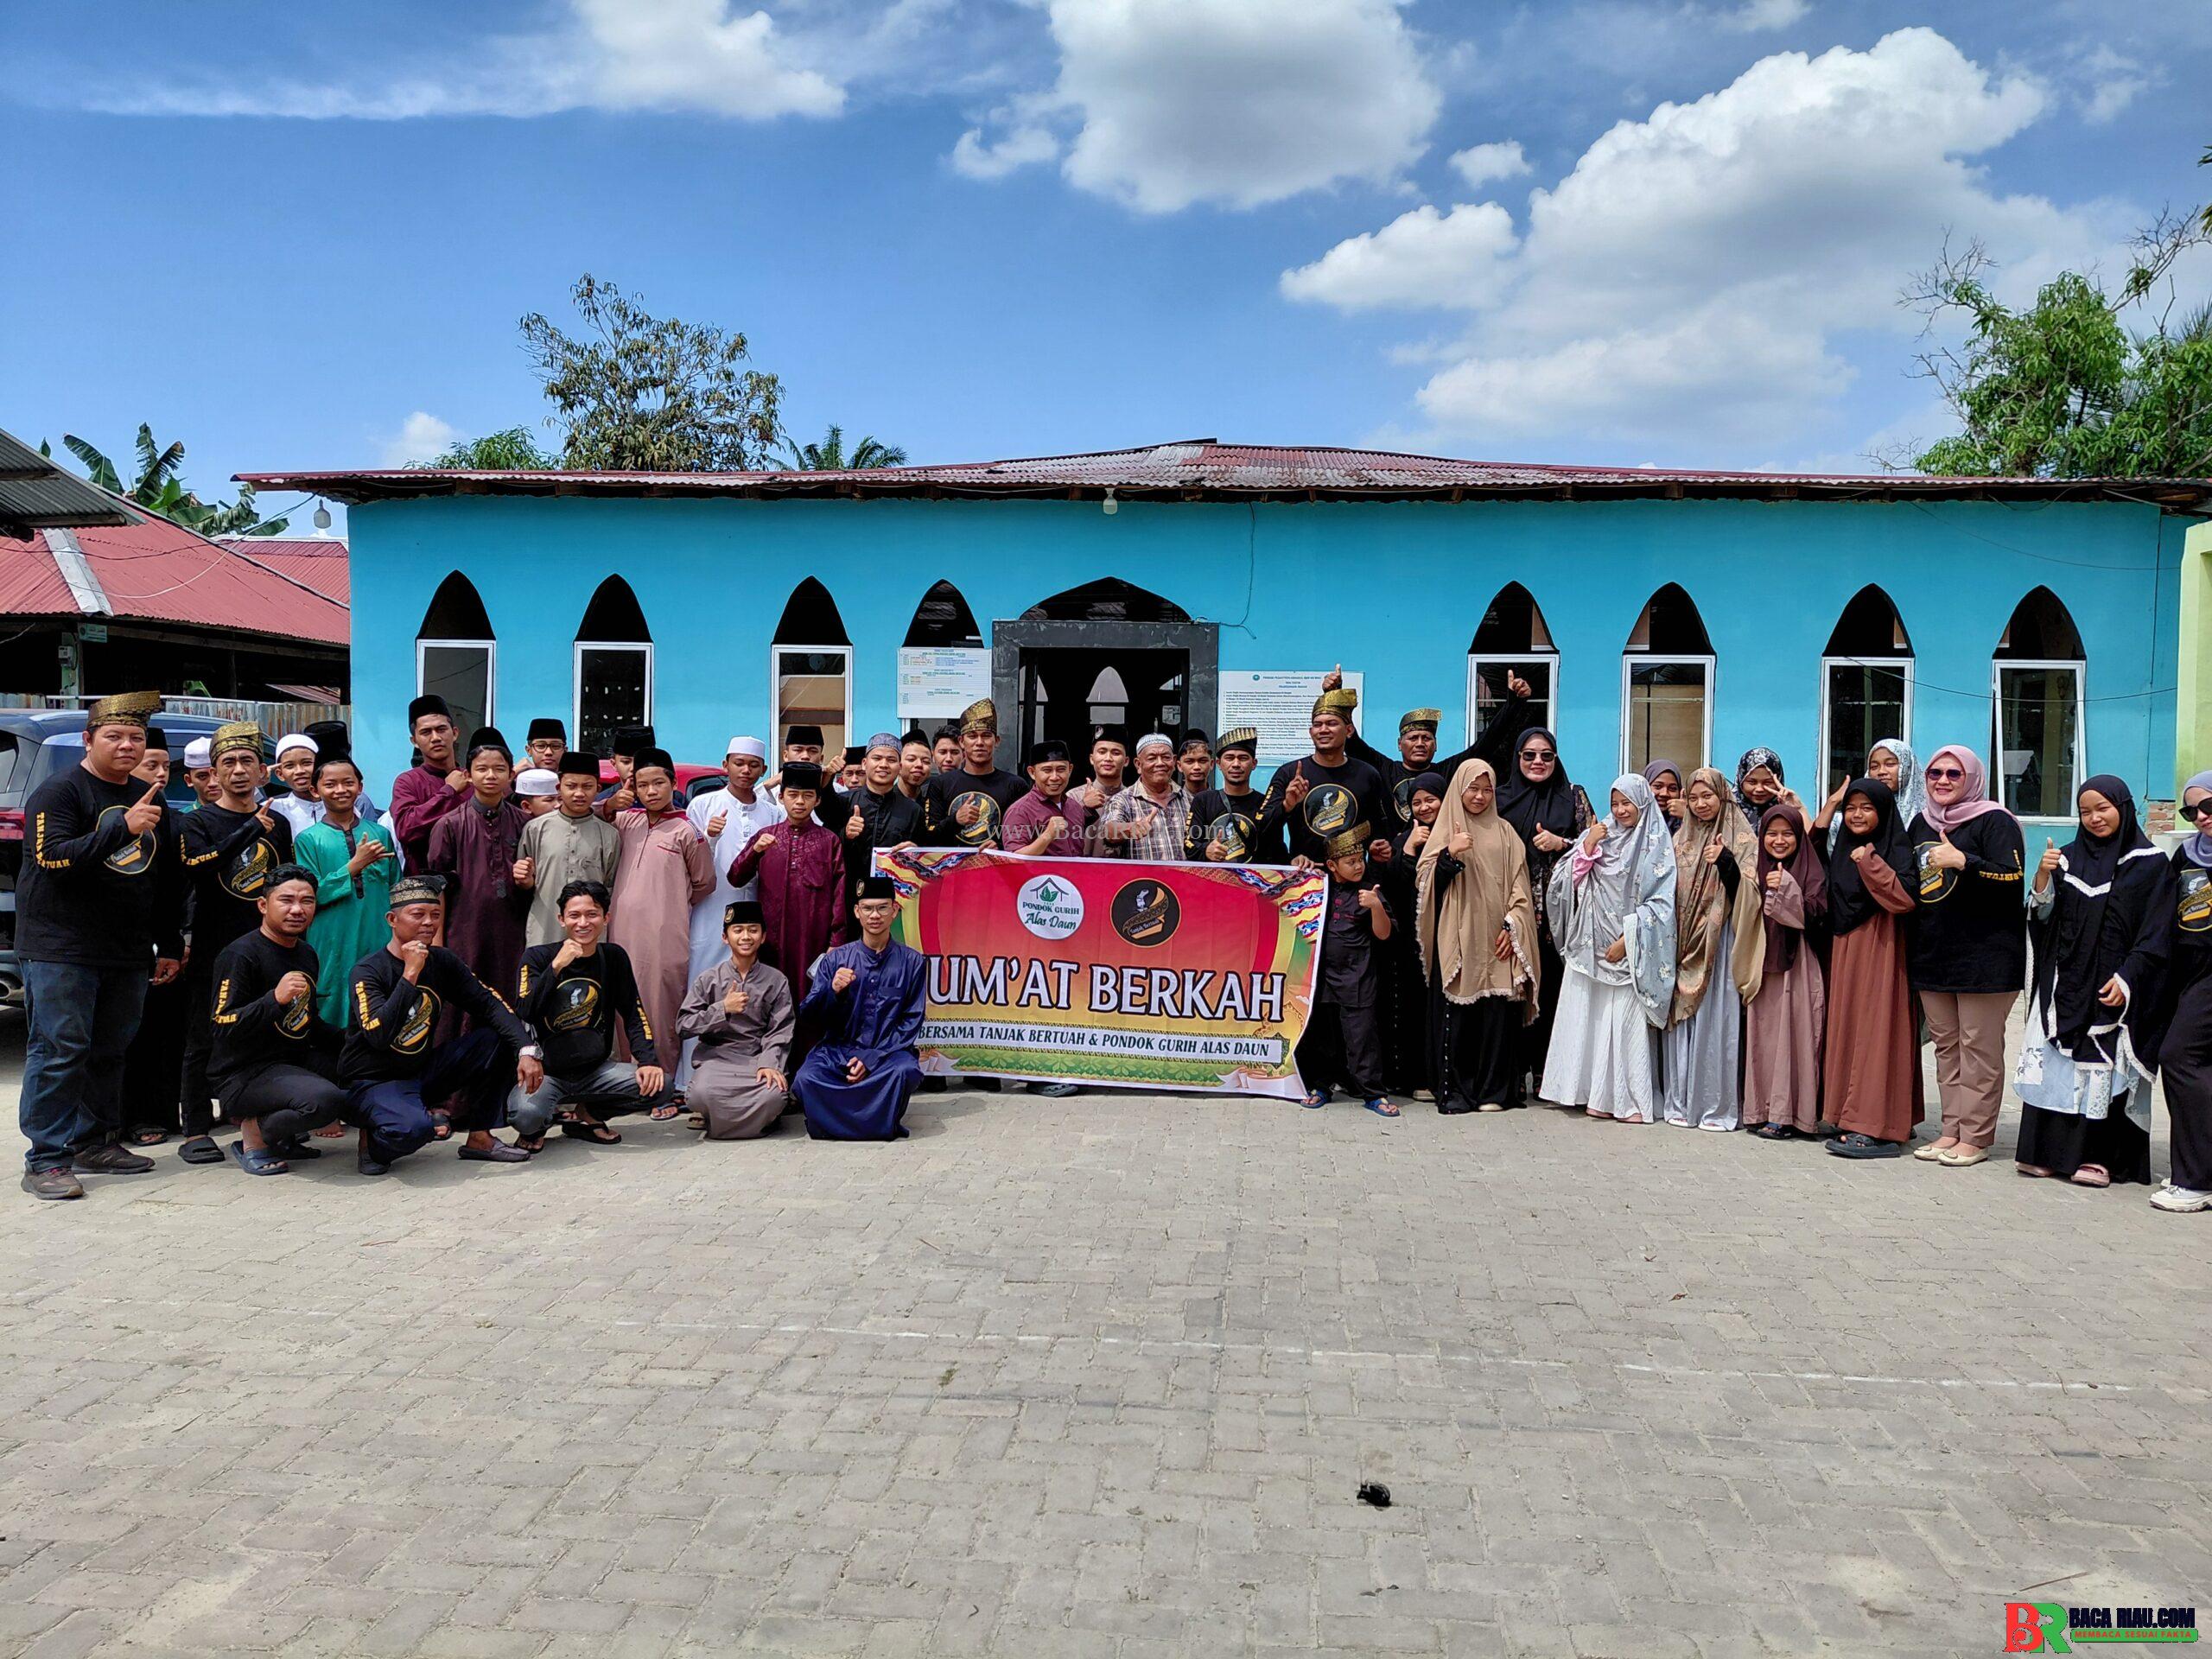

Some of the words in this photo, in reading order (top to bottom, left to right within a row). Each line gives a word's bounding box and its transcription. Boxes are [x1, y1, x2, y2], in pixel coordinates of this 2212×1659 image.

[1022, 901, 1053, 912] PONDOK
[1054, 906, 1080, 915] GURIH
[1024, 912, 1047, 926] Alas
[1048, 915, 1077, 931] Daun
[925, 955, 1080, 1009] UM'AT
[1089, 963, 1287, 1023] BERKAH
[918, 1026, 976, 1039] BERSAMA
[980, 1026, 1025, 1042] TANJAK
[1028, 1029, 1085, 1046] BERTUAH
[1088, 1033, 1098, 1046] &
[1103, 1035, 1154, 1051] PONDOK
[1159, 1038, 1197, 1053] GURIH
[1200, 1040, 1230, 1054] ALAS
[1234, 1042, 1269, 1057] DAUN
